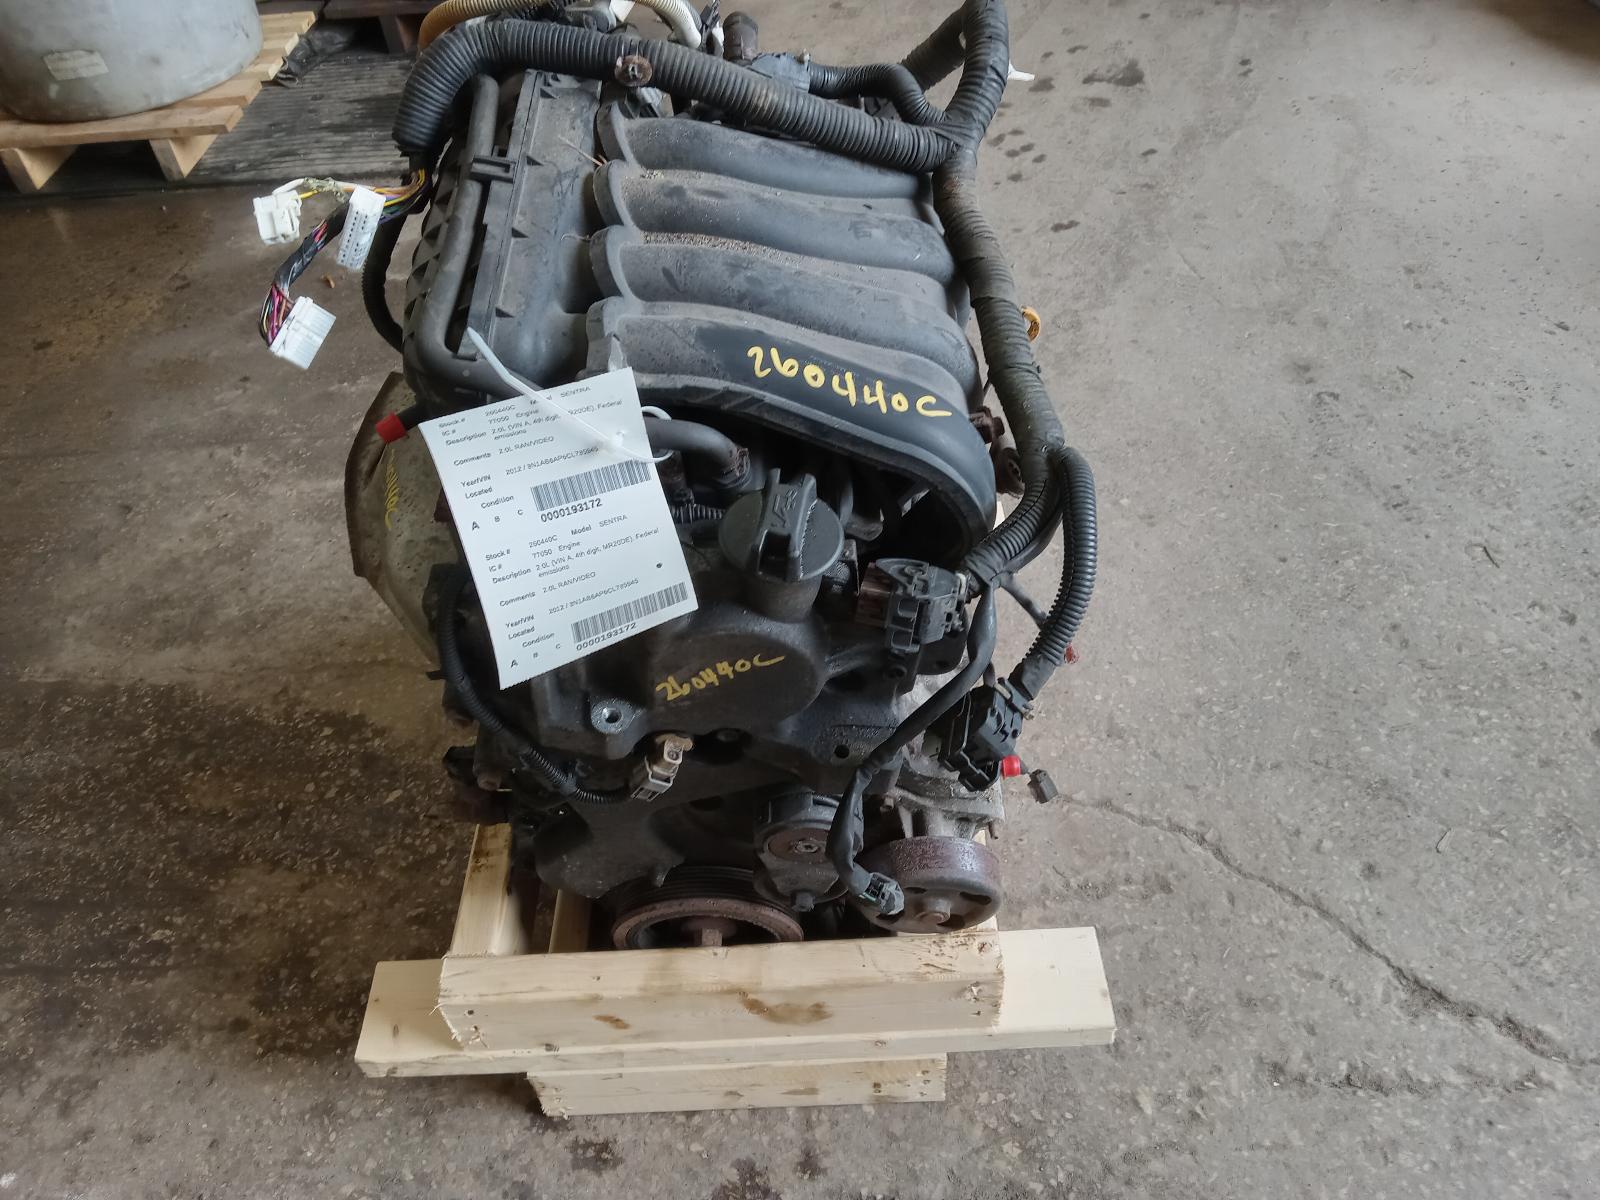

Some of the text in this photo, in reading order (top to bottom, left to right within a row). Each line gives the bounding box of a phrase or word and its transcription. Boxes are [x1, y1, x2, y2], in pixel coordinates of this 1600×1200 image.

[747, 346, 952, 417] 260440C
[561, 386, 591, 397] SENTRA
[488, 416, 509, 424] 77050
[445, 432, 486, 445] Description
[494, 428, 527, 440] emissions
[453, 435, 554, 466] Comments 2.0L RAN/VIDEO
[461, 474, 491, 487] Year/VIN
[506, 466, 522, 475] 2012
[465, 486, 493, 499] Located
[481, 495, 514, 509] Condition
[540, 498, 603, 523] 0000193172
[472, 520, 480, 531] A
[494, 515, 500, 523] B
[485, 550, 505, 561] Stock
[529, 534, 558, 548] 260440C
[571, 524, 592, 536] Model
[599, 515, 627, 527] SENTRA
[492, 568, 532, 584] Description
[536, 562, 550, 571] 2.0L
[551, 557, 566, 567] (VIN
[635, 528, 659, 539] Federal
[532, 548, 552, 558] 77050
[558, 541, 581, 551] Engine
[538, 564, 570, 578] emissions
[500, 571, 596, 607] Comments 2.0L RAN/VIDEO
[505, 614, 534, 628] Year/VIN
[549, 604, 565, 615] 2012
[508, 626, 535, 640] Located
[522, 632, 555, 648] Condition
[576, 622, 636, 651] 0000193172
[511, 659, 518, 668] A
[656, 653, 785, 701] 260440C
